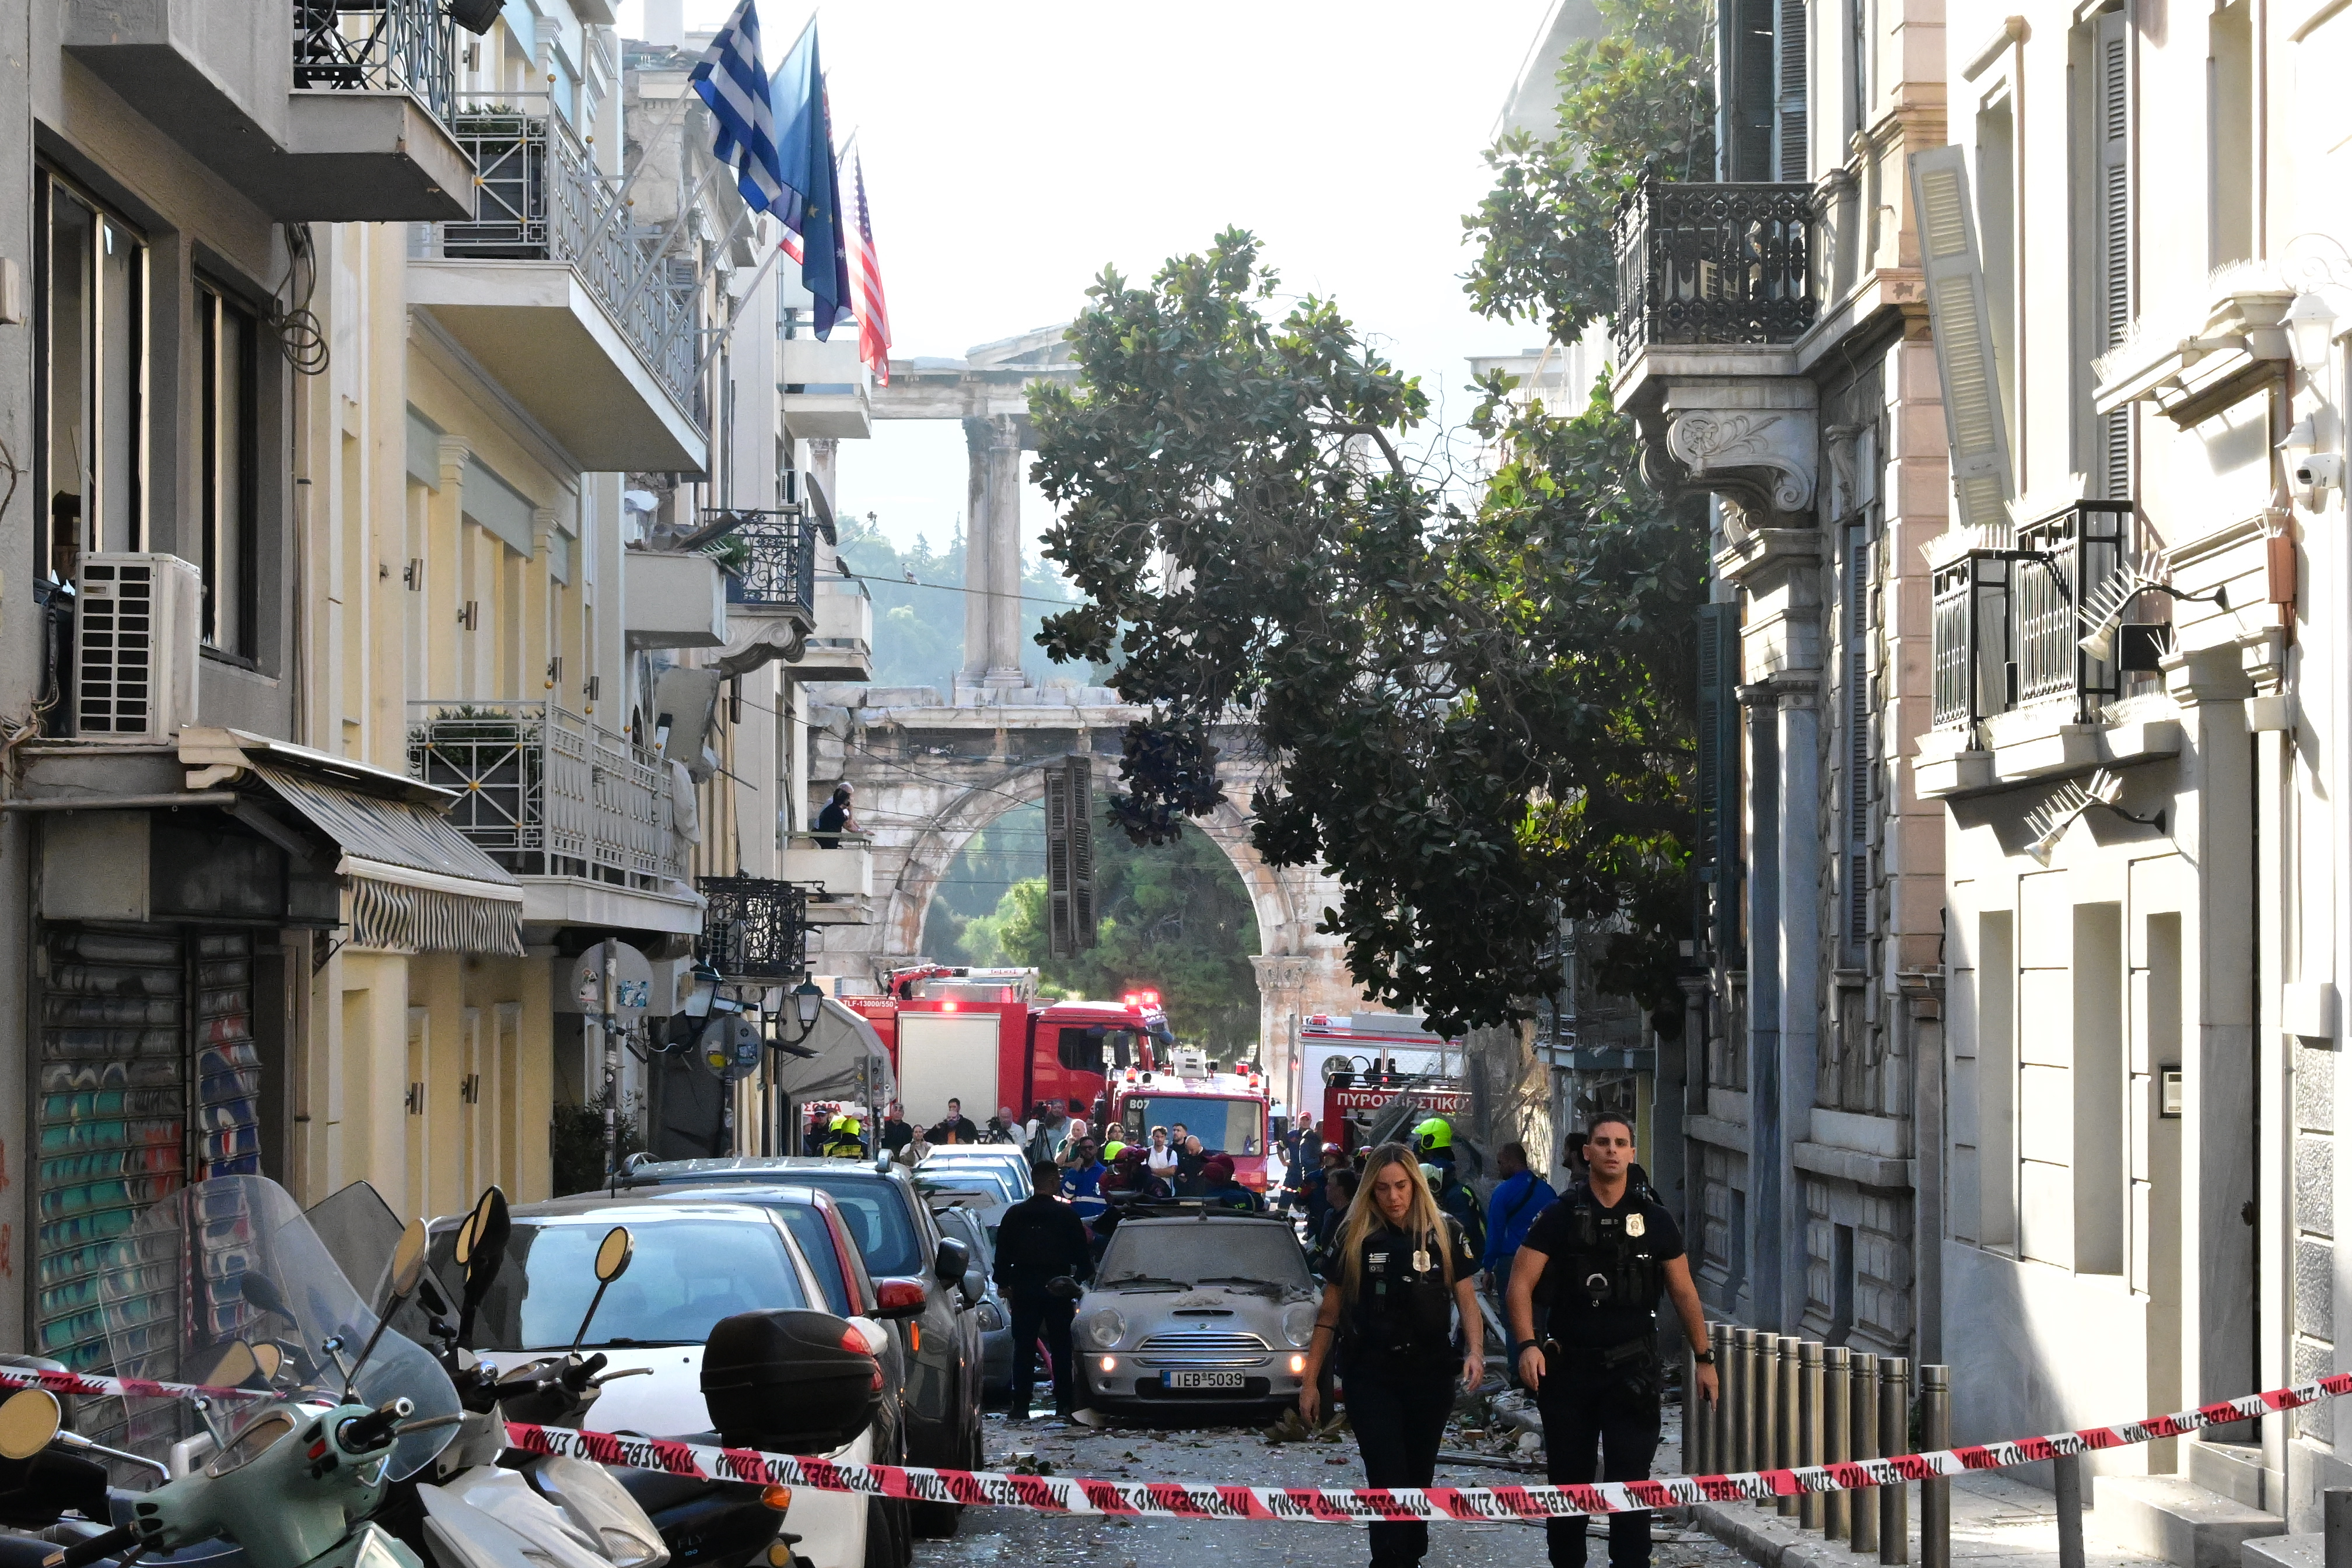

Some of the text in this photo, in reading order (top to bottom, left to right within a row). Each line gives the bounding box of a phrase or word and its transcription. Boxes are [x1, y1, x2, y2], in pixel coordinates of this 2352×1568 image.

[1337, 1093, 1466, 1110] ΠΥΡΟΣΕΣΤΙΚΟ
[523, 1429, 698, 1473] ΠΥΡΟΣΒΕΣΤΙΚΟ ΣΩΜΑ
[715, 1453, 886, 1493] ΠΥΡΟΣΒΕΣΤΙΚΟ ΣΩΜΑ
[905, 1472, 1070, 1508] ΠΥΡΟΣΒΕΣΤΙΚΟ ΣΩΜΑ
[1794, 1456, 1944, 1492] ΠΥΡΟΣΒΕΣΤΙΚΟ ΣΩΜΑ
[1087, 1485, 1250, 1516] ΠΥΡΟΣΒΕΣΤΙΚΟ ΣΩΜΑ
[1450, 1489, 1608, 1517] ΠΥΡΟΣΒΕΣΤΙΚΟ ΣΩΜΑ
[1623, 1476, 1776, 1508] ΠΥΡΟΣΒΕΣΤΙΚΟ ΣΩΜΑ
